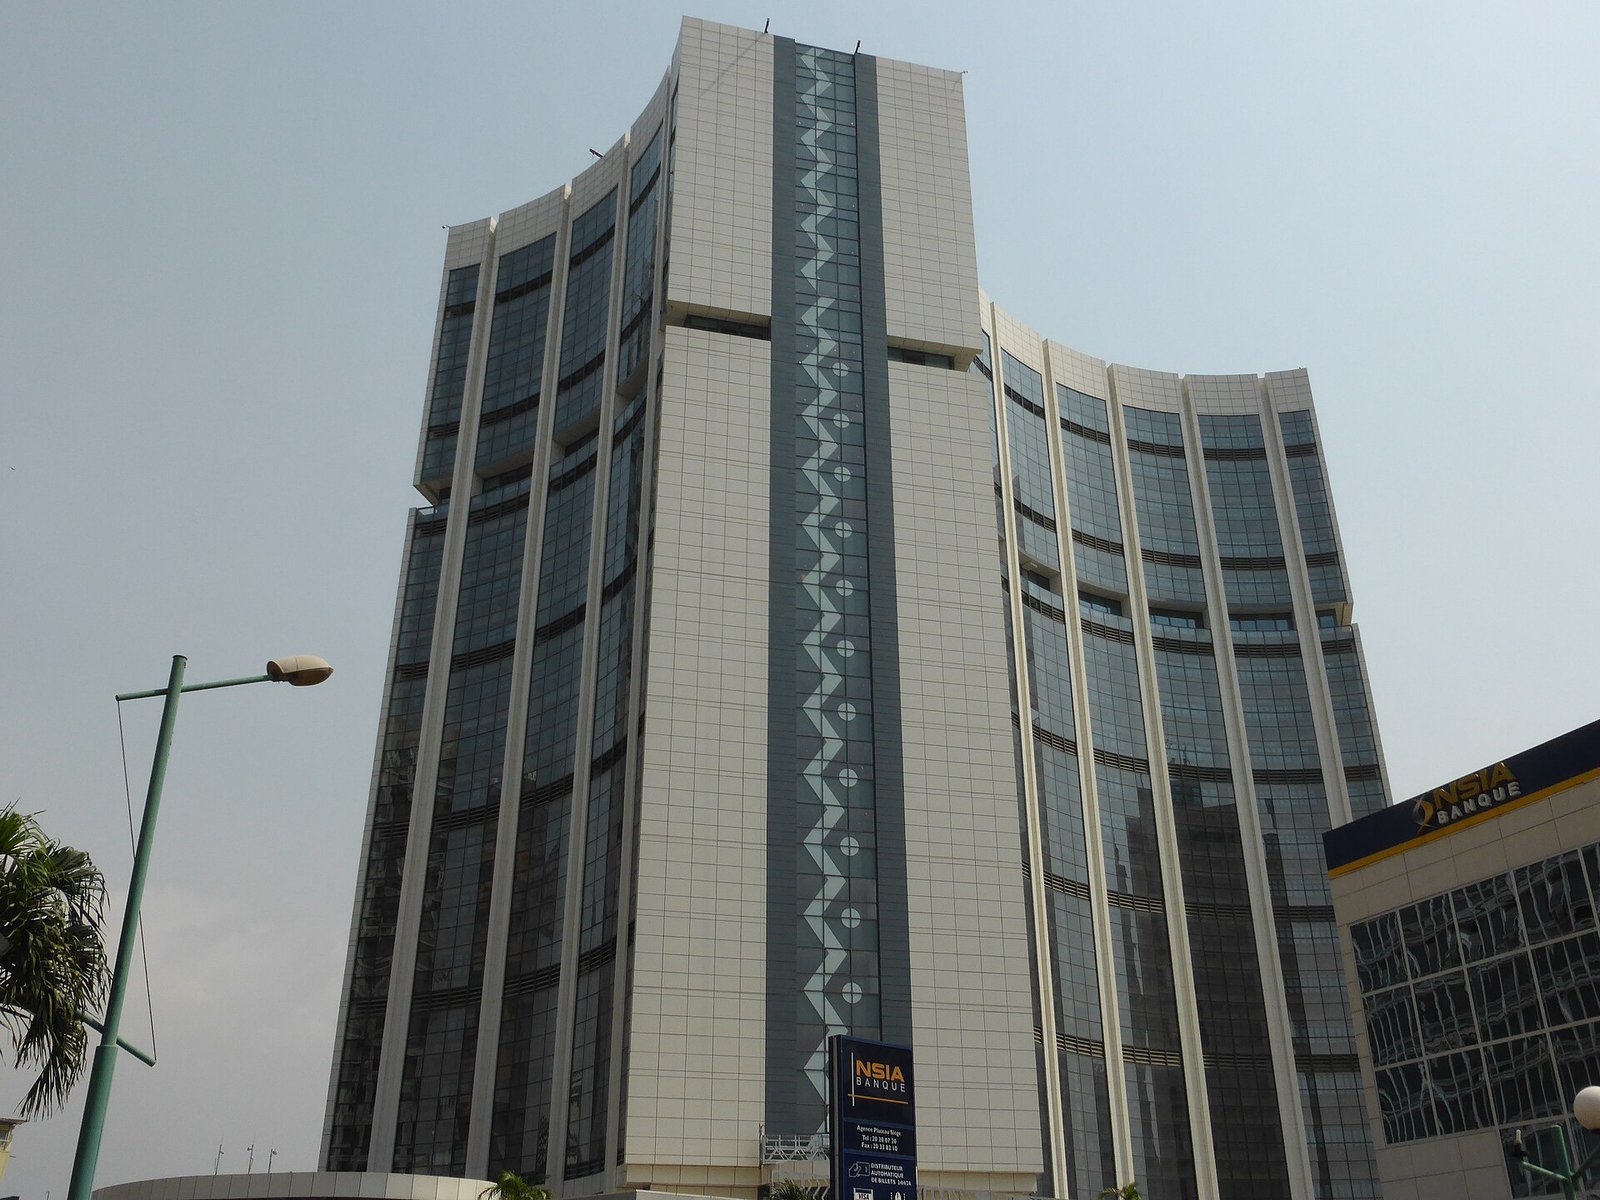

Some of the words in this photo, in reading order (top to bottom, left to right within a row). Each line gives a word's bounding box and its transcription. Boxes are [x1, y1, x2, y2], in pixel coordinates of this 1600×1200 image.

[1433, 761, 1516, 810] NSIA
[1437, 781, 1522, 825] BANQUE
[856, 1059, 905, 1082] NSIA
[856, 1076, 906, 1093] BANQUE
[871, 1163, 903, 1171] DISTRIBUTEUR
